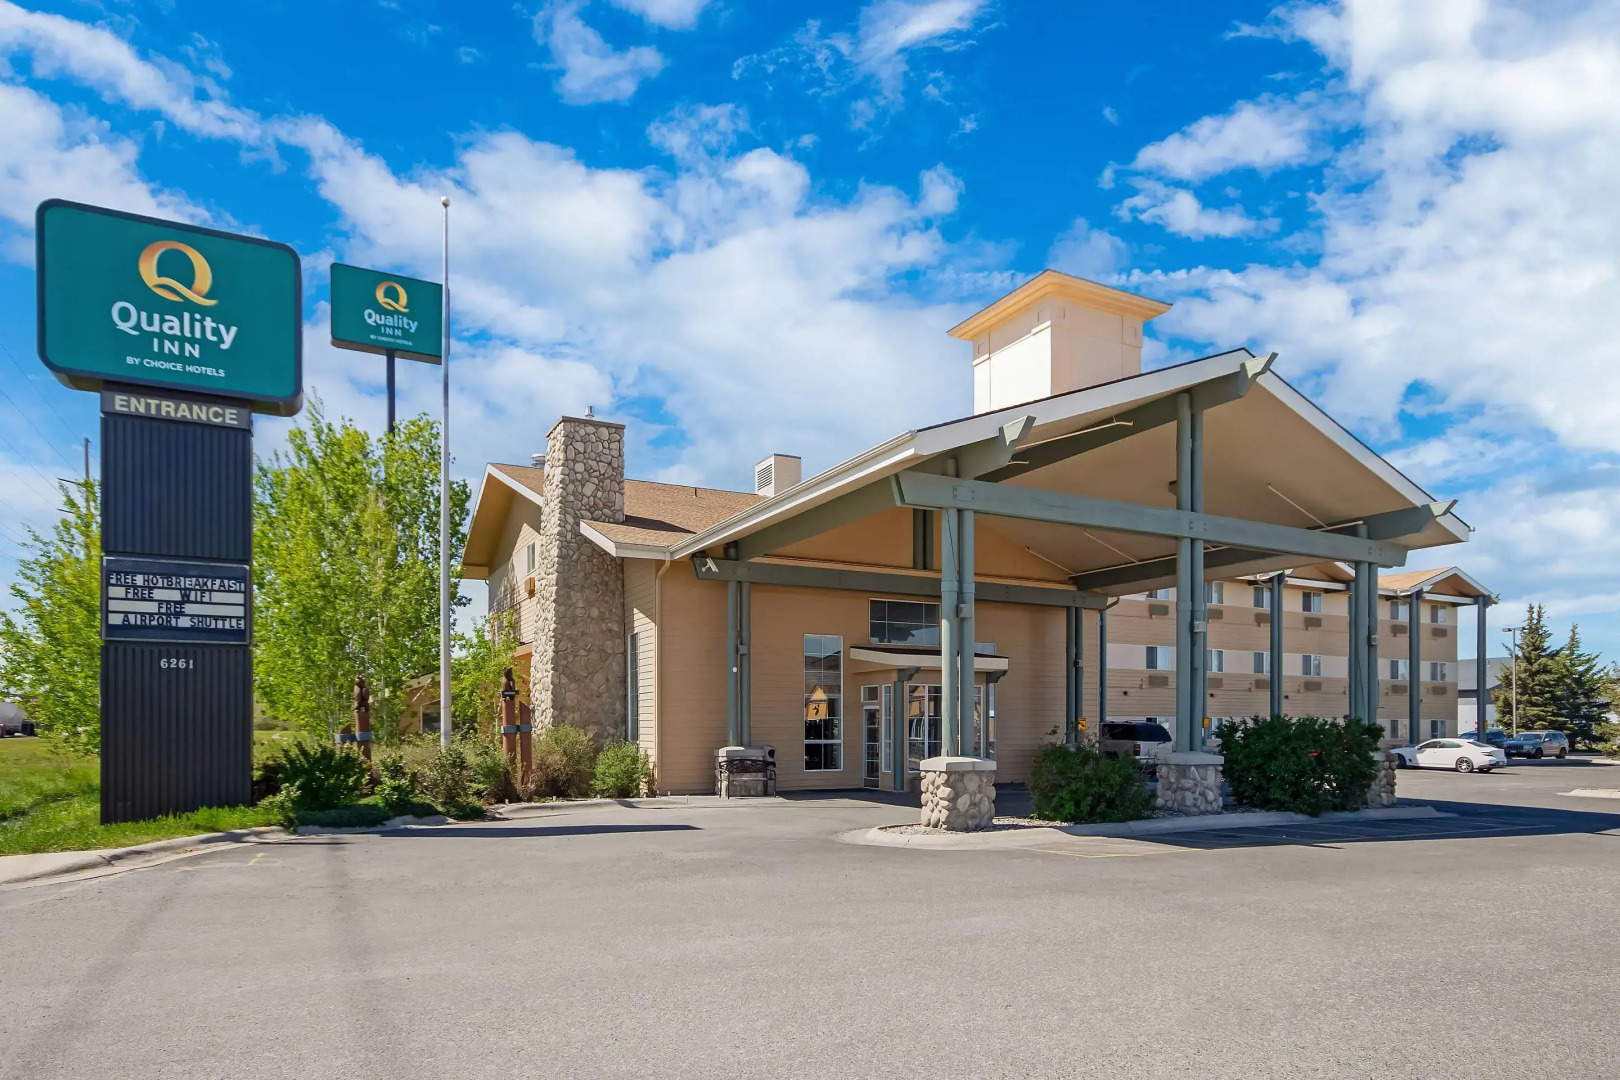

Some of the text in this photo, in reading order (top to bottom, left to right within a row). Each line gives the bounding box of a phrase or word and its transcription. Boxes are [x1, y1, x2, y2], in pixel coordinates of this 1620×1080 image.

[138, 240, 218, 306] Q
[375, 281, 410, 313] Q
[111, 301, 238, 350] Quality
[363, 309, 418, 333] Quality
[381, 326, 402, 337] INN
[153, 338, 200, 359] INN
[126, 356, 226, 377] BY CHOICE HOTELS
[114, 395, 239, 425] ENTRANCE
[109, 573, 138, 585] FREE
[125, 587, 212, 602] FREE WIFI
[158, 602, 186, 614] FREE
[122, 614, 243, 629] AIRPORT SHUTTLE
[160, 658, 194, 669] 6261
